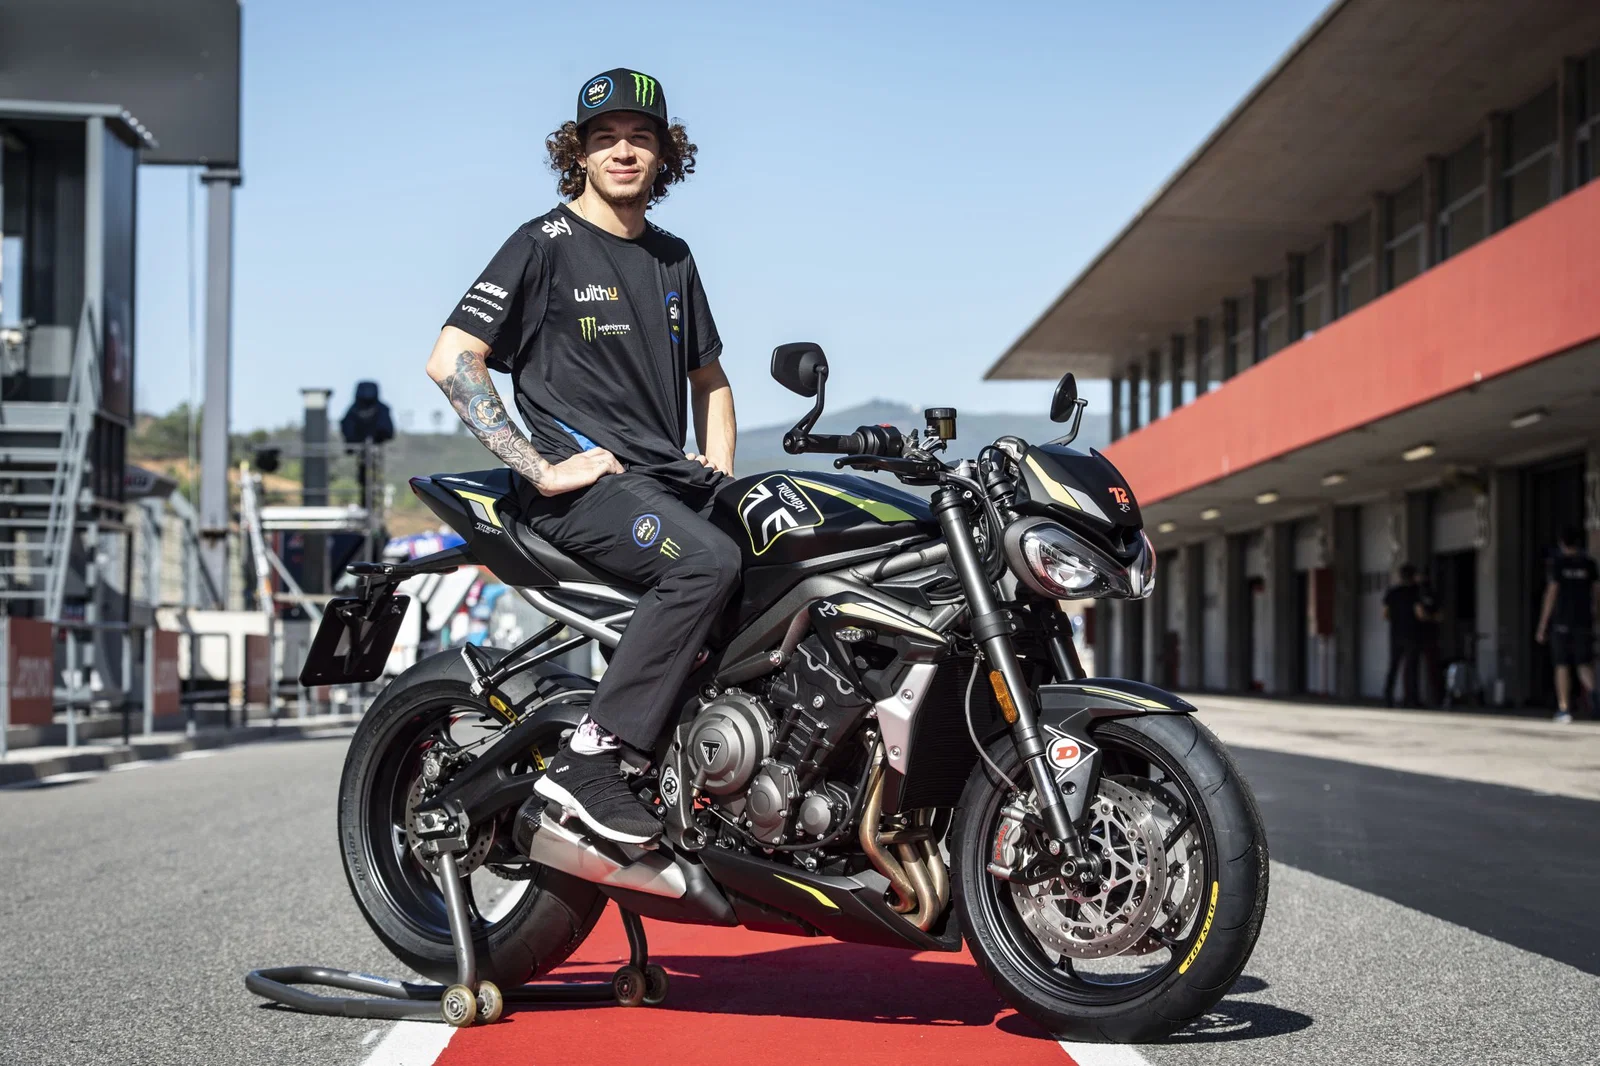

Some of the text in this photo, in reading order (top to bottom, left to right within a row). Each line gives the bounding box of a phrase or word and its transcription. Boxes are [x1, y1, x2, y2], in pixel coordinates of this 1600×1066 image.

[588, 82, 607, 96] sky
[541, 217, 573, 239] sky
[473, 281, 509, 300] KTM
[470, 294, 503, 311] DUNLOP
[597, 323, 631, 333] MONSTER
[775, 482, 808, 513] TRIUMPH
[1108, 487, 1130, 504] 72
[637, 518, 651, 539] sky
[1055, 745, 1079, 760] D
[348, 831, 366, 881] DUNLOP
[1186, 903, 1215, 966] DUNLOP
